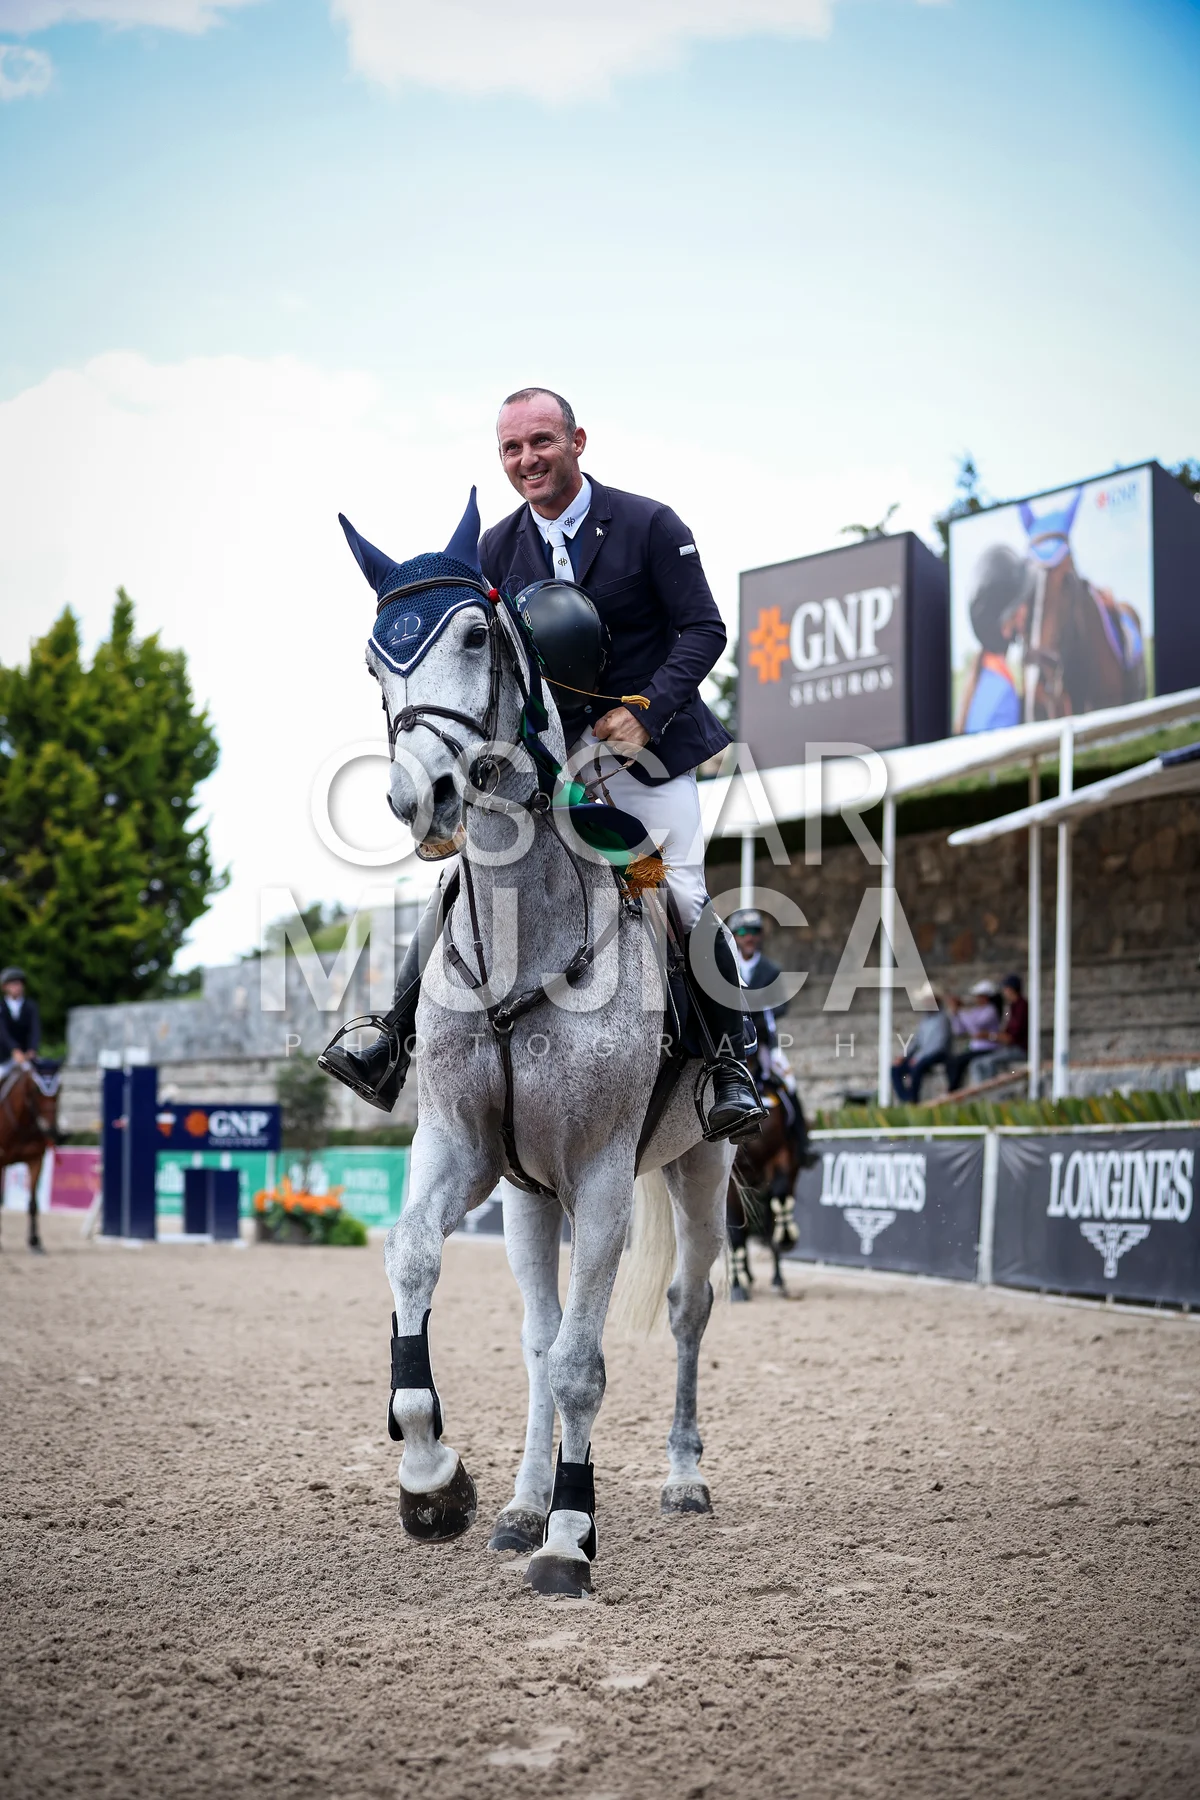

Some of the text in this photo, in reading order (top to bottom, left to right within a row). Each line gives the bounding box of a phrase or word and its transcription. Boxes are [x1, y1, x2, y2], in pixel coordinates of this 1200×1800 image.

[789, 586, 893, 672] GNP
[208, 1110, 269, 1137] GNP
[819, 1151, 926, 1212] LONGINES
[1046, 1148, 1195, 1223] LONGINES
